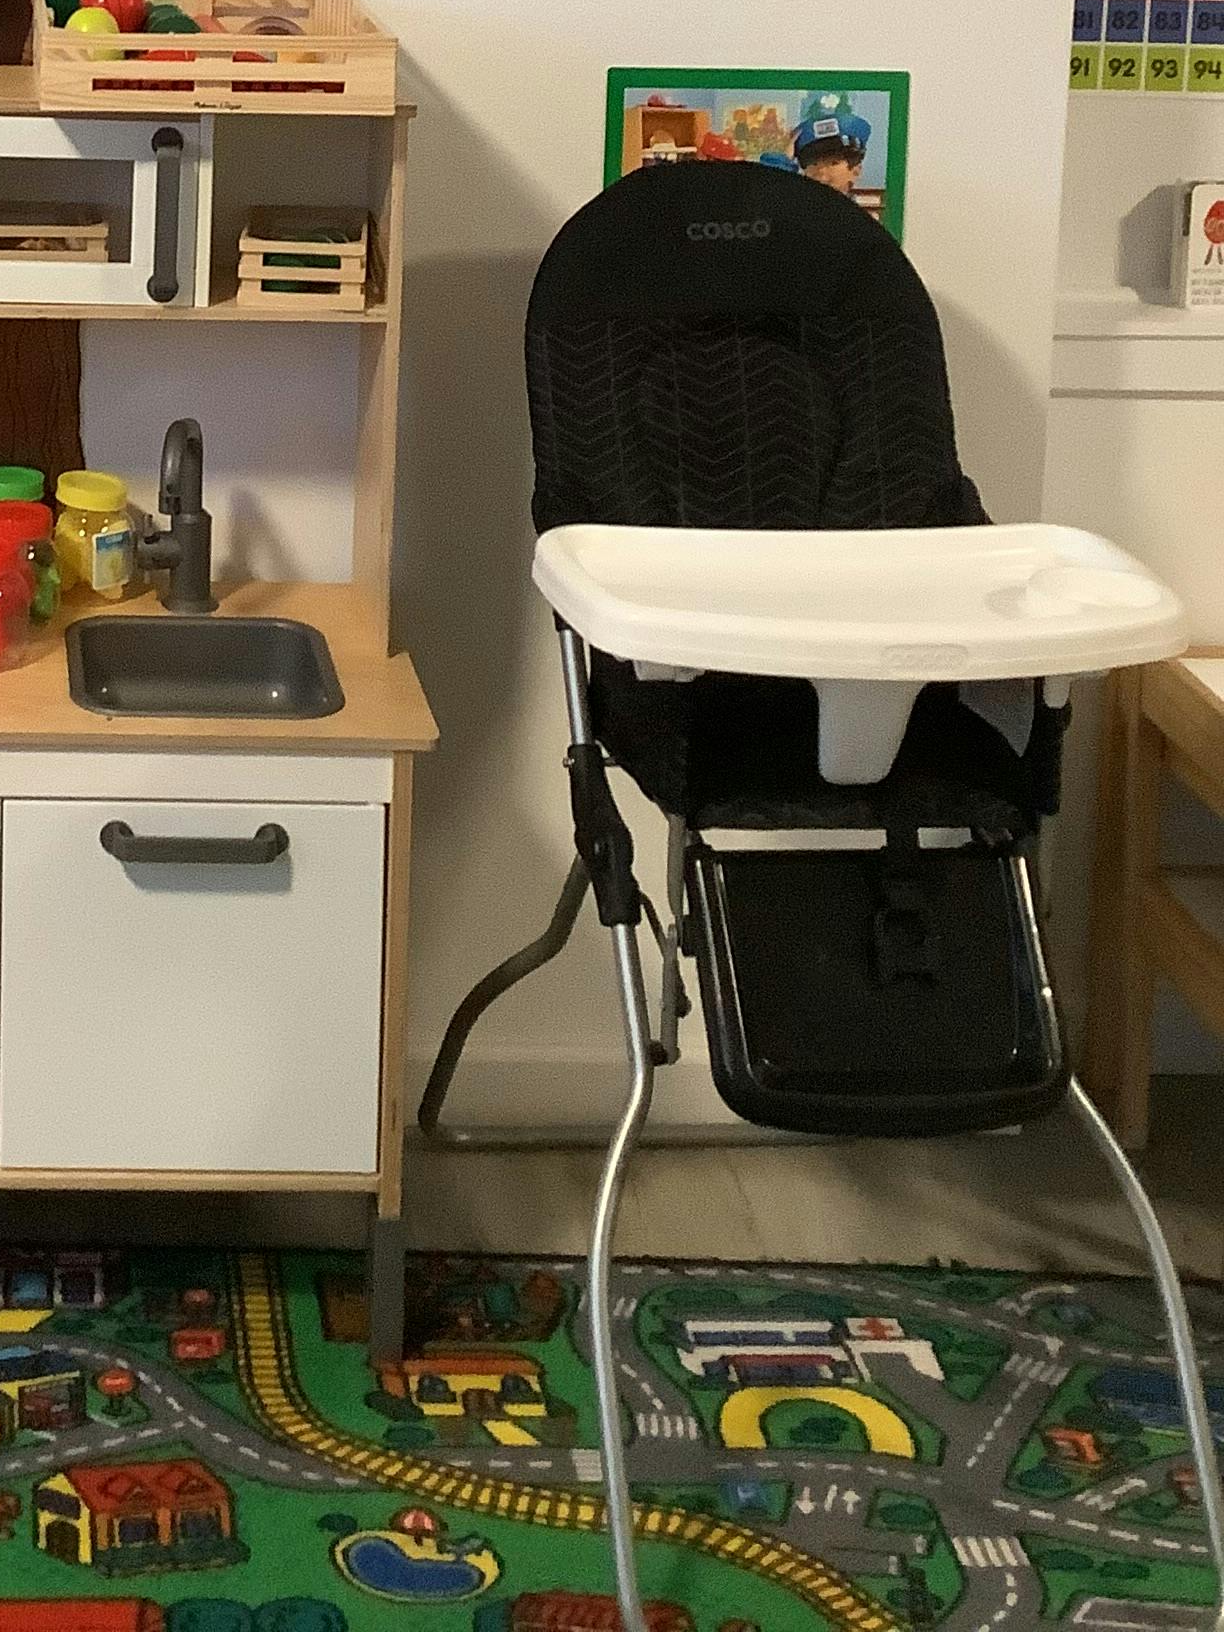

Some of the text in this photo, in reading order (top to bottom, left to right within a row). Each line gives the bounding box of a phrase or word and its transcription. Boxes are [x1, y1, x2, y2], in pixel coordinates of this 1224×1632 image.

[1070, 56, 1222, 79] 91 92 93 94
[686, 220, 771, 241] COSCO
